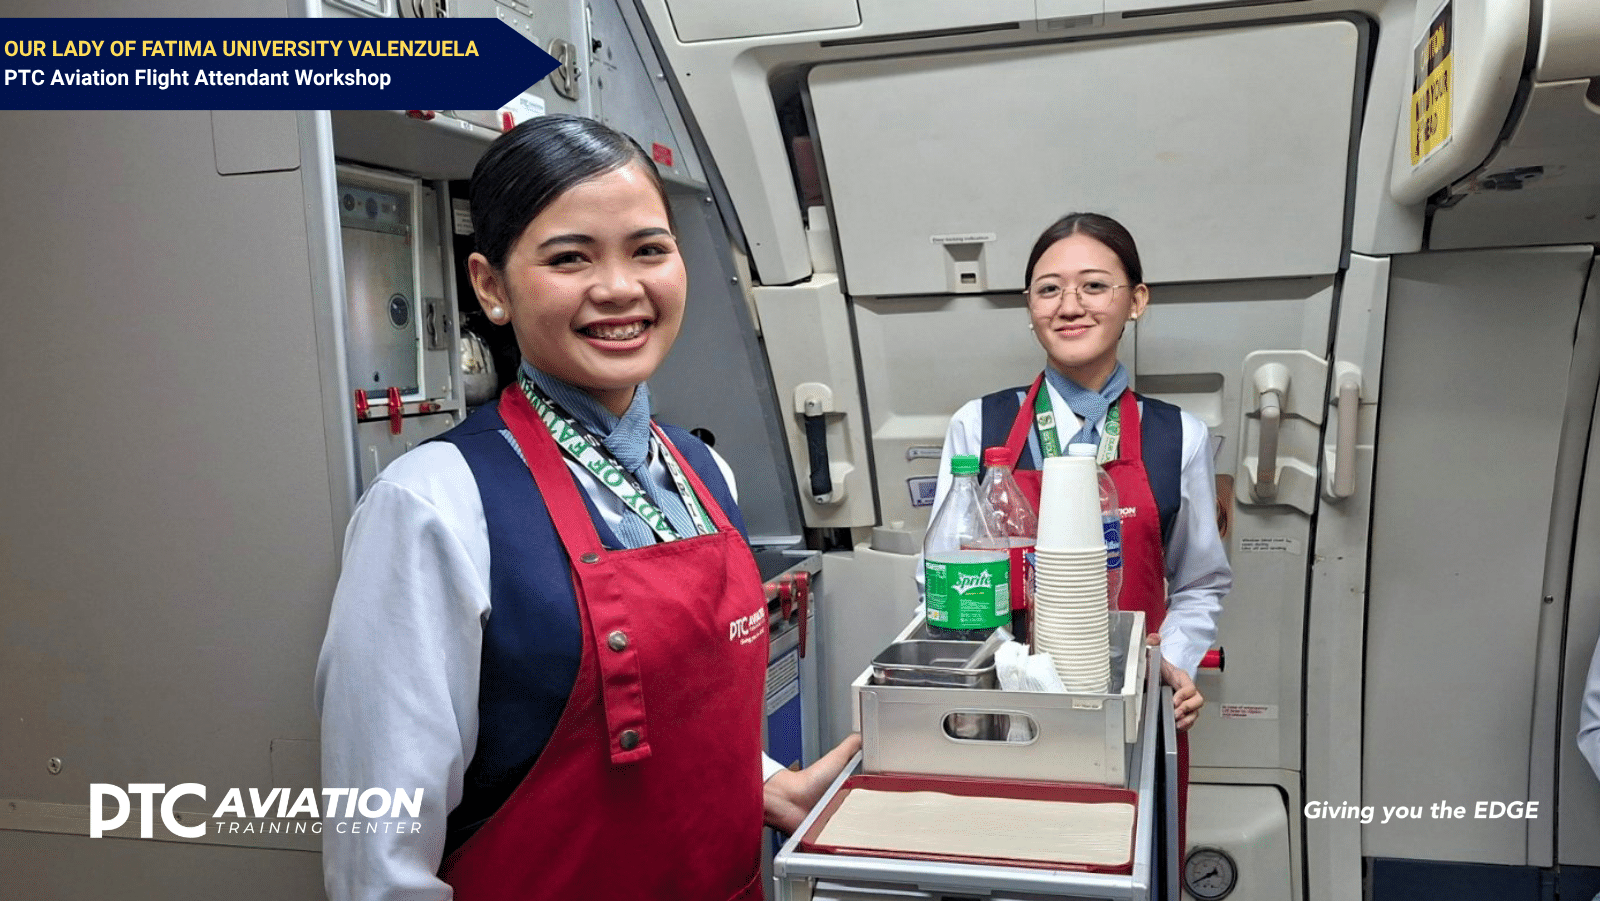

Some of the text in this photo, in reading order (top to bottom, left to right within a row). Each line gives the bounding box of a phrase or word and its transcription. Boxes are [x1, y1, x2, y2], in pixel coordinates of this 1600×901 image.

[588, 459, 625, 488] OF
[953, 571, 993, 590] Sprite
[729, 615, 750, 642] PTC
